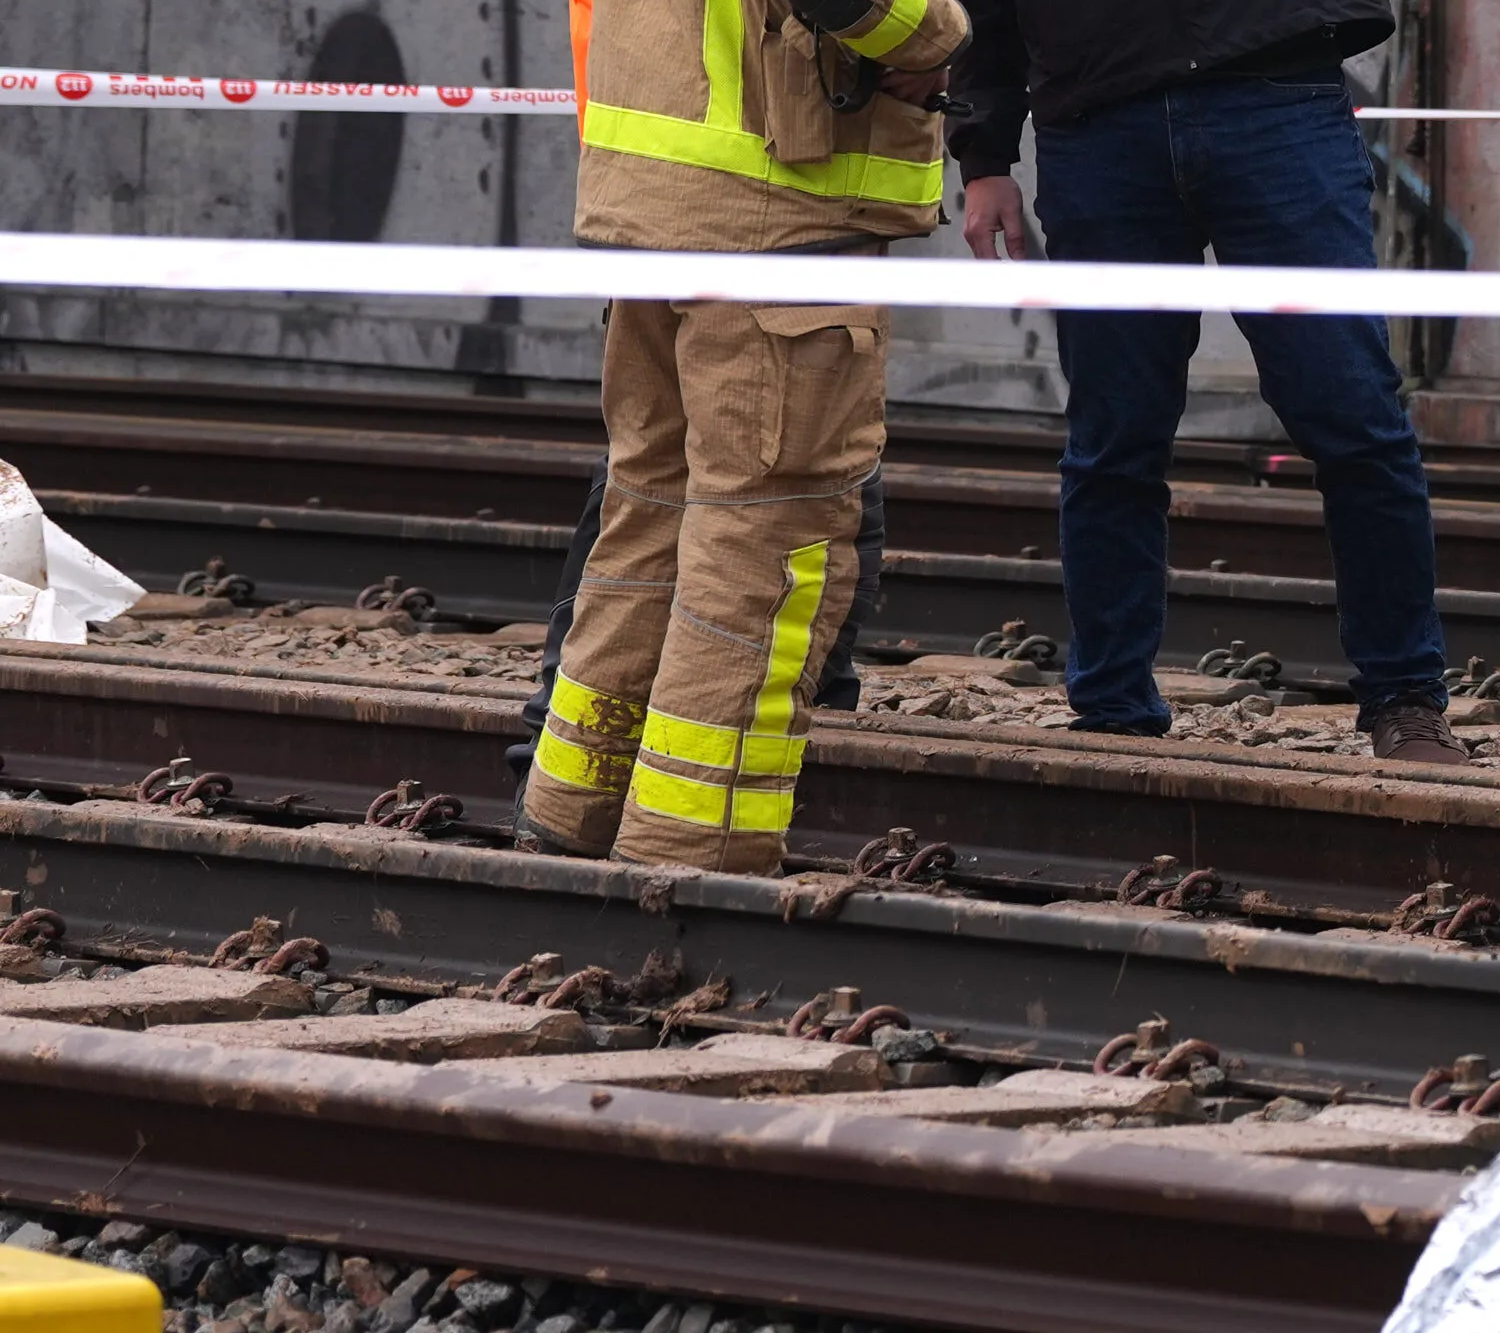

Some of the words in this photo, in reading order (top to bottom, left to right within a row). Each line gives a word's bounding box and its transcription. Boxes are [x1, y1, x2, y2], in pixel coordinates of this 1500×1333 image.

[1, 76, 37, 91] NO
[110, 83, 205, 99] bombers
[491, 89, 577, 106] ombers
